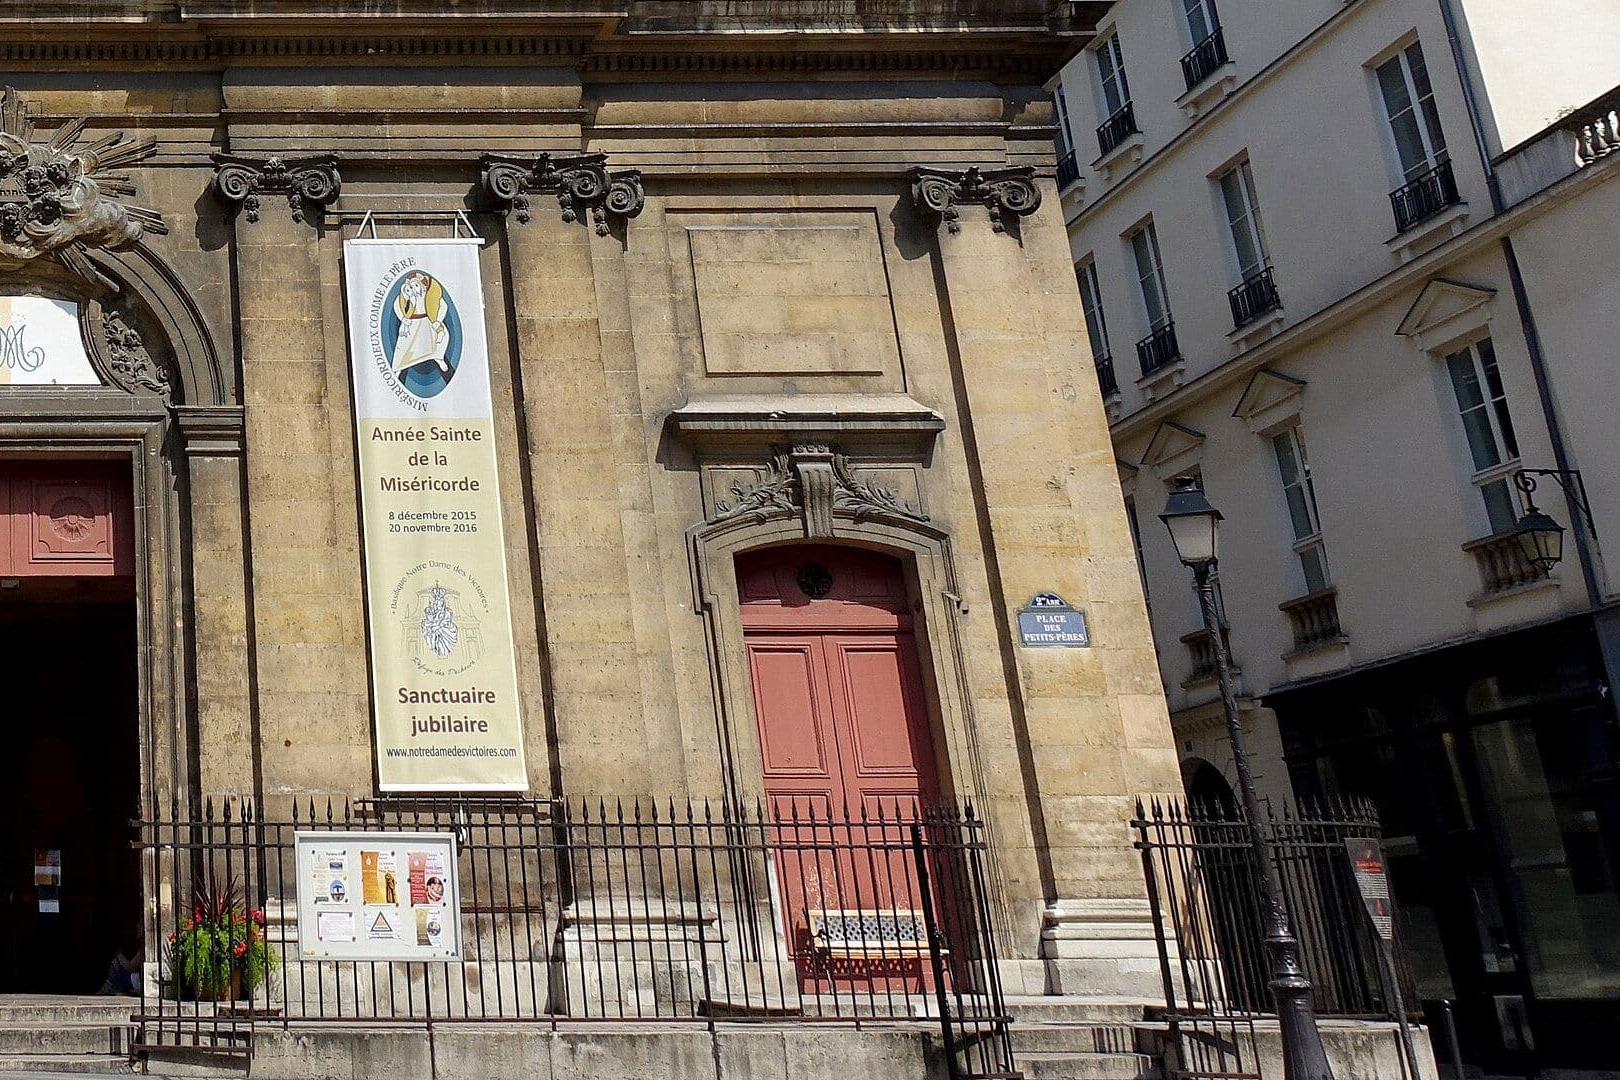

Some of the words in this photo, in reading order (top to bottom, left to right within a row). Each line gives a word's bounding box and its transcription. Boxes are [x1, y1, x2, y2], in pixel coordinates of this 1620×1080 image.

[389, 256, 416, 277] PÈRE
[379, 274, 393, 289] LE
[369, 287, 386, 328] COMME
[370, 331, 428, 412] MISÉRICORDIEUX
[372, 426, 425, 441] Année
[430, 426, 482, 441] Sainte
[408, 451, 429, 466] de
[434, 450, 448, 466] la
[380, 476, 480, 492] Miséricorde
[388, 511, 395, 520] 8
[398, 510, 448, 520] décembre
[451, 511, 477, 520] 2015
[389, 524, 401, 533] 20
[403, 523, 450, 533] novembre
[453, 523, 478, 532] 2016
[1035, 615, 1067, 623] PLACE
[1024, 632, 1084, 641] PETITS-PÈRES
[398, 687, 496, 704] Sanctuaire
[411, 715, 488, 737] jubilaire
[386, 745, 516, 758] www.notredamedesvictoires.com
